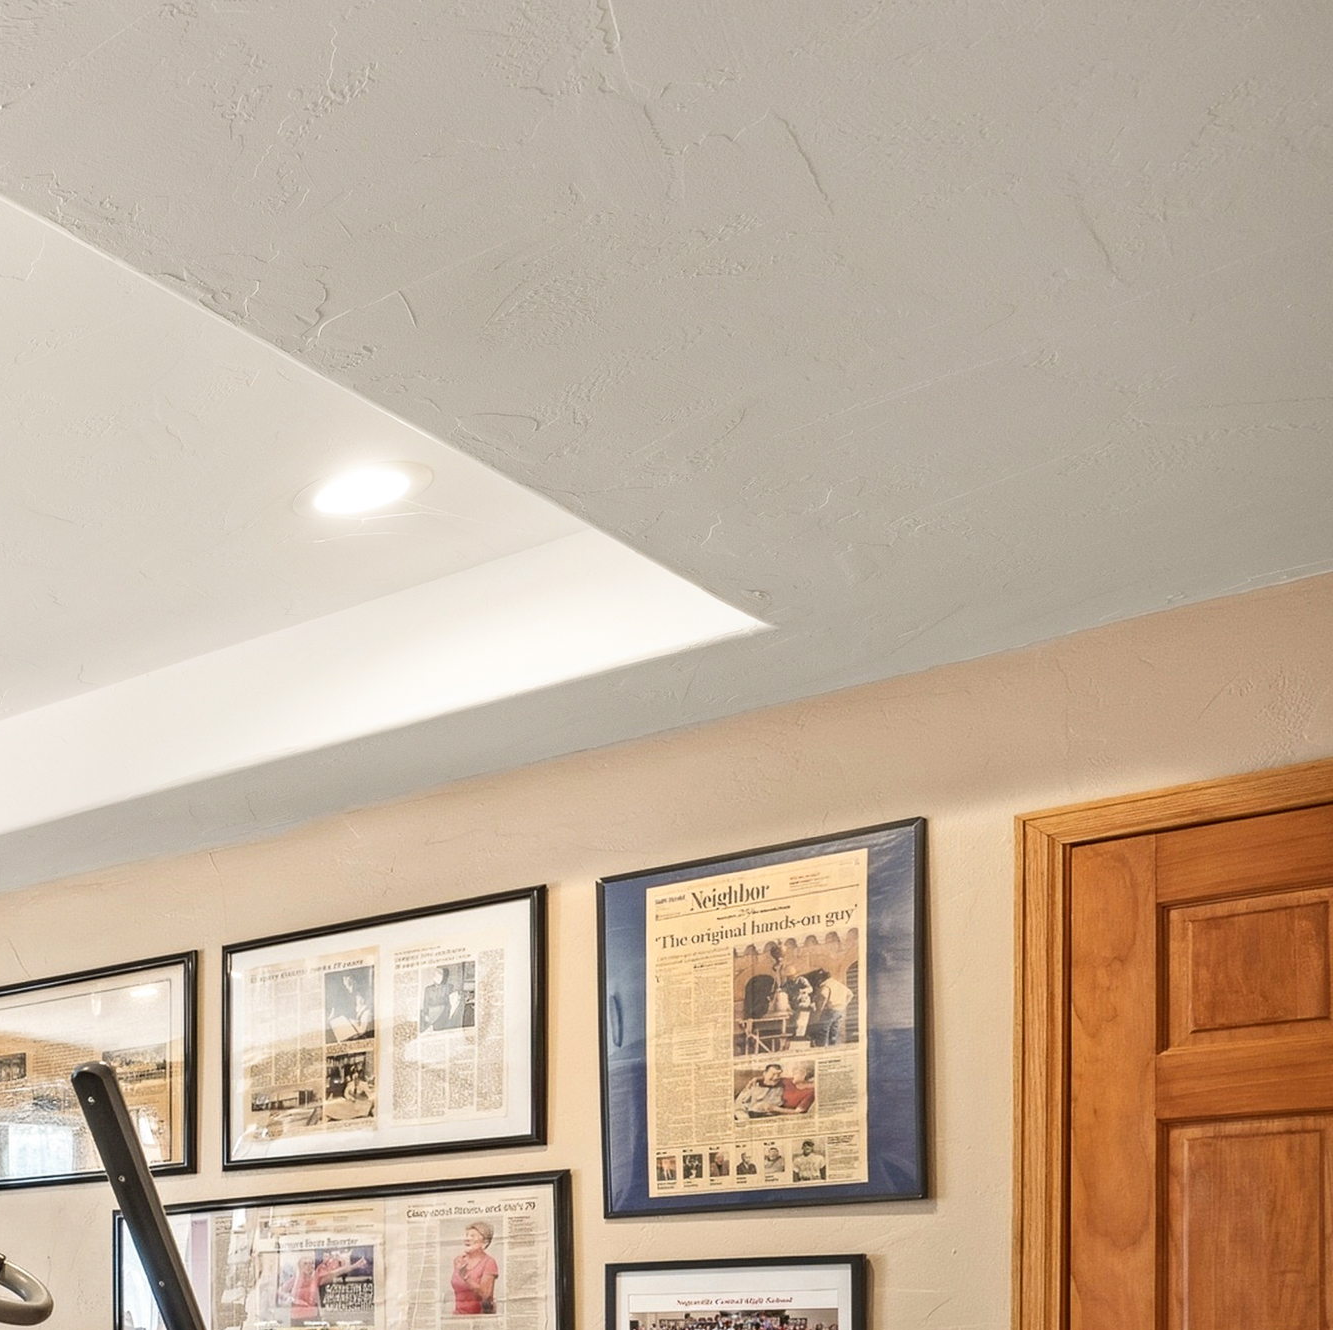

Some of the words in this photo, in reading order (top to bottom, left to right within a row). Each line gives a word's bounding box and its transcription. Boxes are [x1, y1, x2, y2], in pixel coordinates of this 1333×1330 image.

[689, 883, 770, 911] Neighbor
[691, 923, 747, 945] original
[751, 914, 821, 936] hands-on
